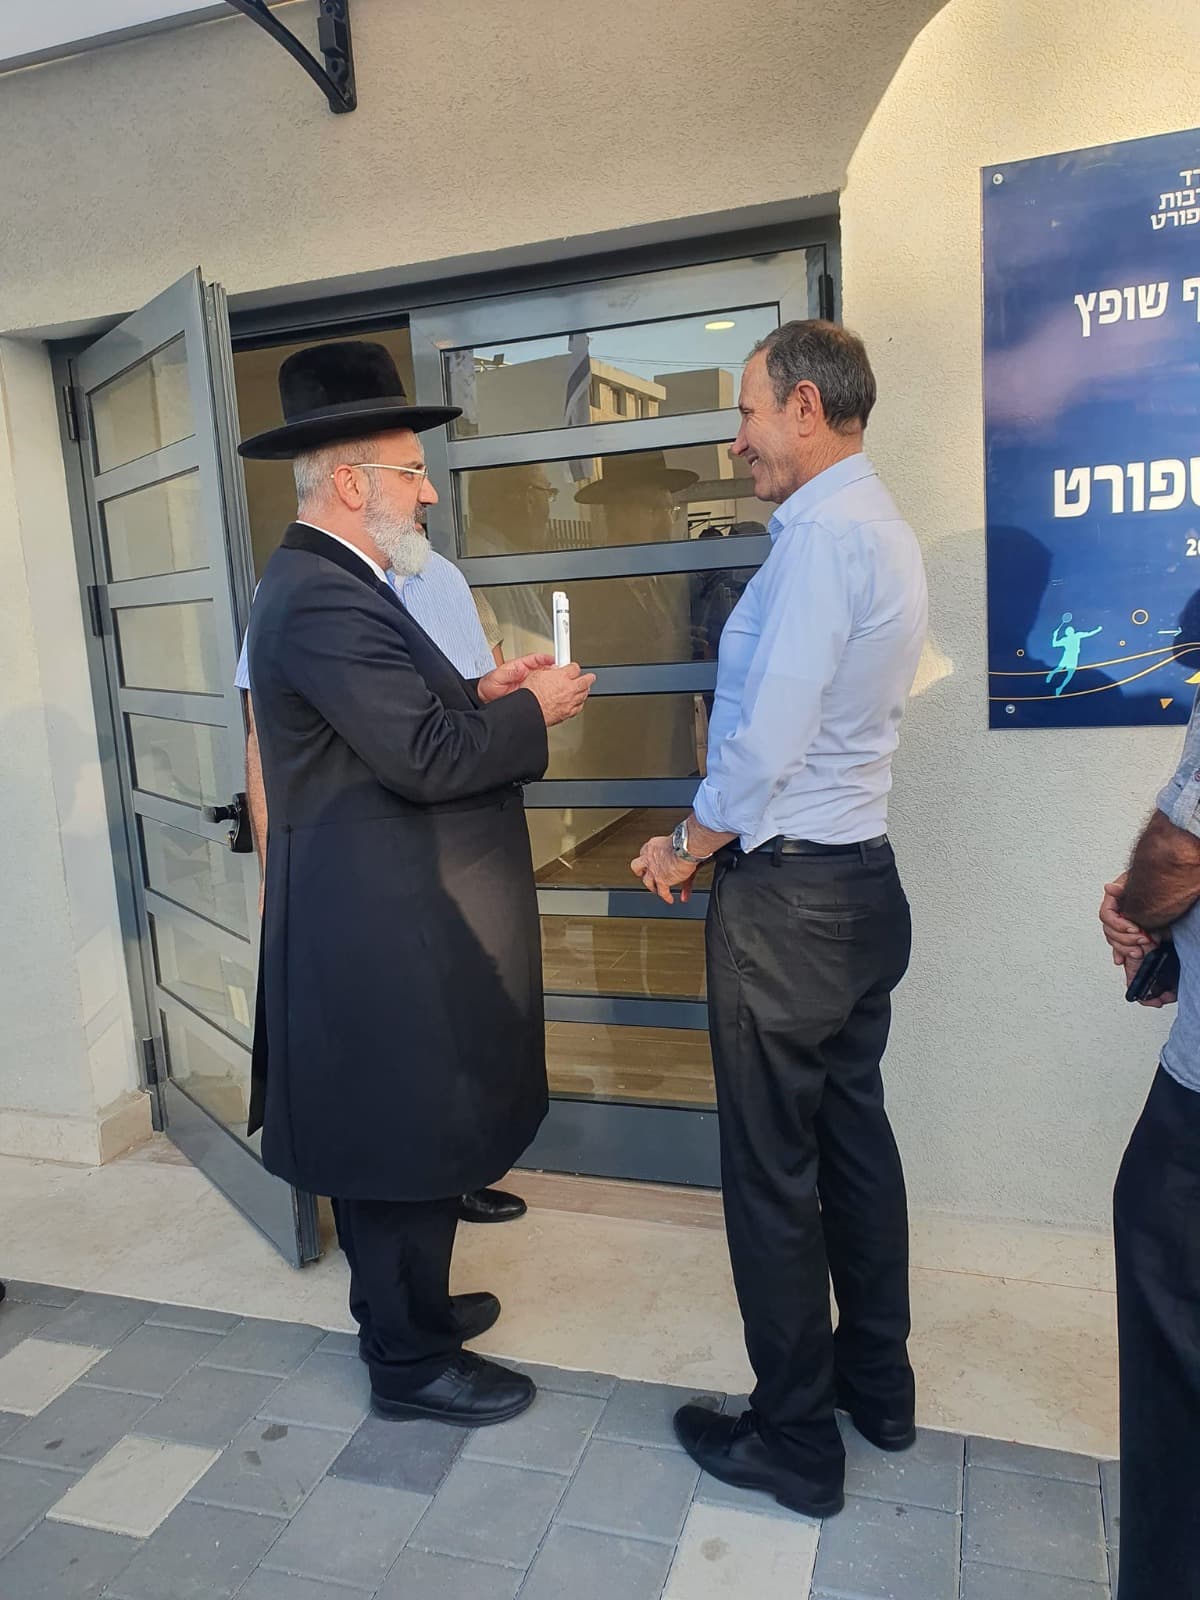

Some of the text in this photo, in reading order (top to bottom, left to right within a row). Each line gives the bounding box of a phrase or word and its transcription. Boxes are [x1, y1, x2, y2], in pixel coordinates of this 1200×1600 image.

[1159, 188, 1200, 210] בות
[1074, 282, 1169, 337] שופץ
[1053, 457, 1200, 518] פורט
